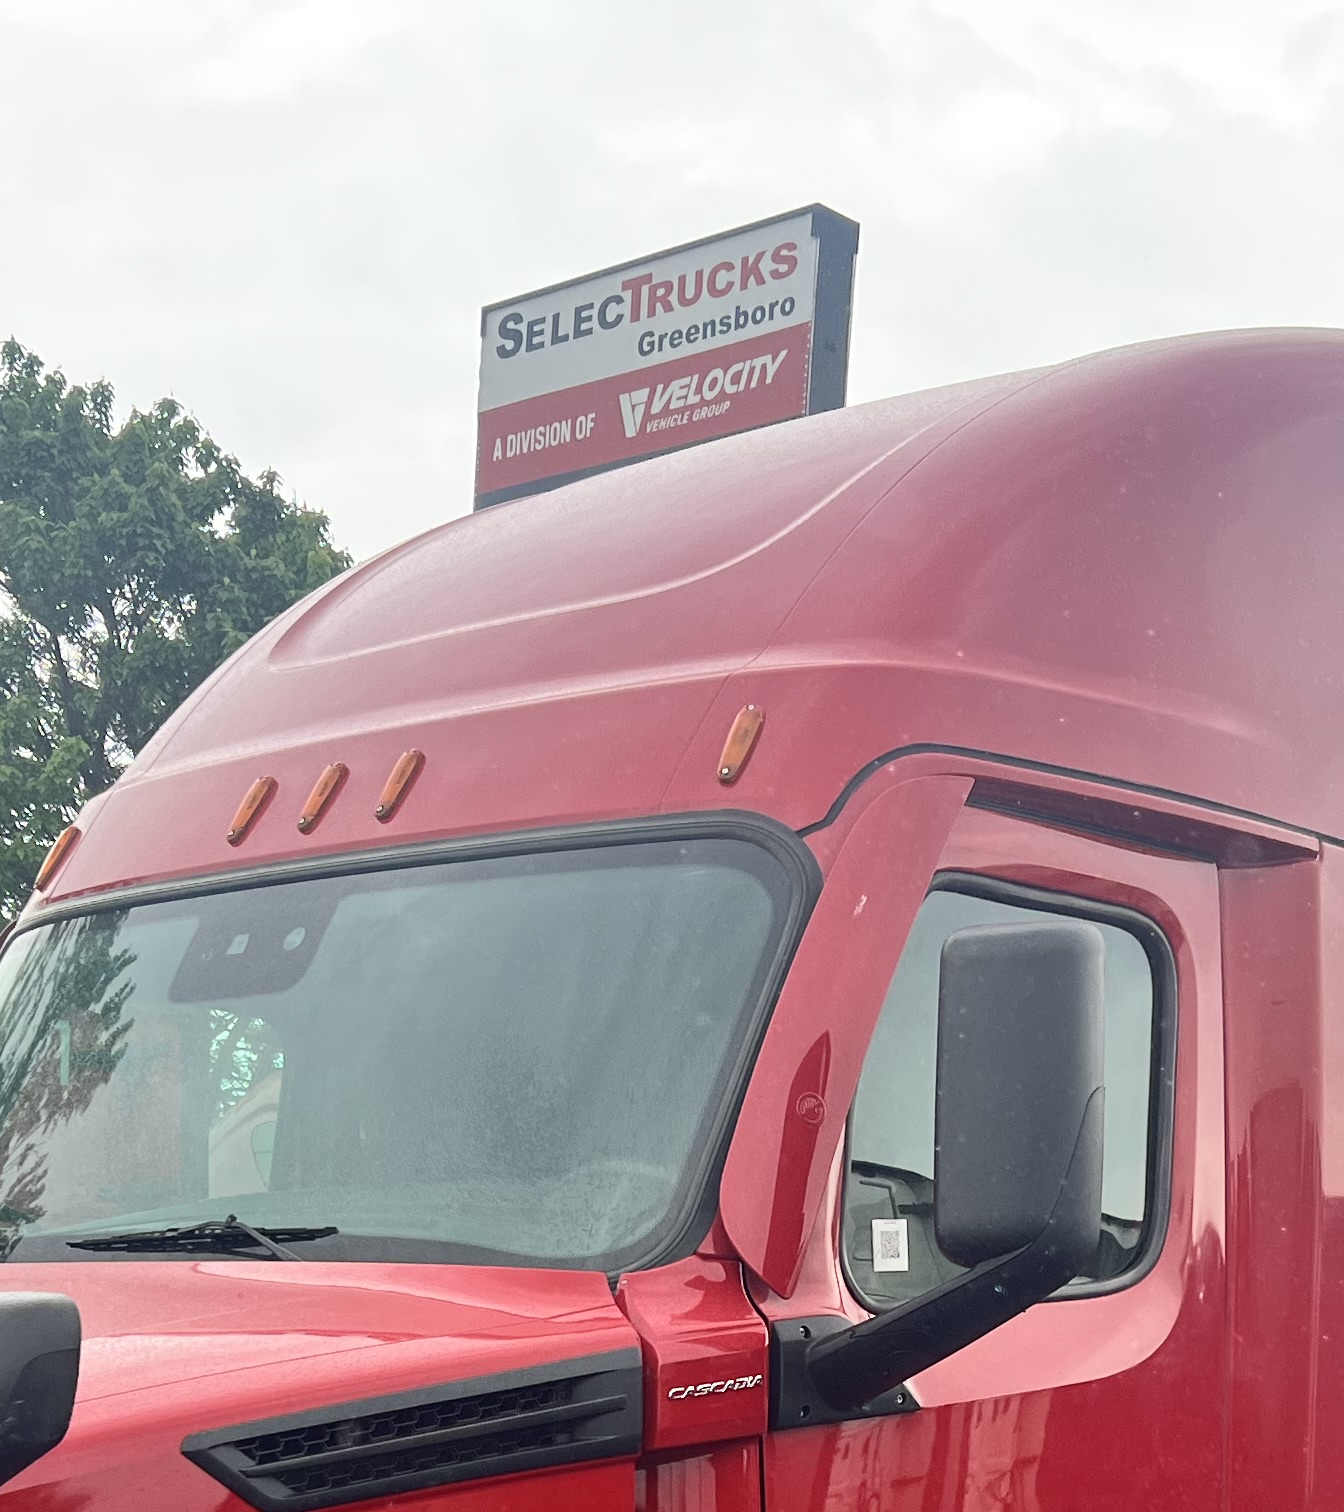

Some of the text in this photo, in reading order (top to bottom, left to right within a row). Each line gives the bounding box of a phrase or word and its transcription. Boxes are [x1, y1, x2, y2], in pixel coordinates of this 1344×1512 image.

[638, 296, 796, 357] Greensboro
[650, 350, 788, 414] VELOCITY
[492, 413, 596, 461] A DIVISION OF
[646, 401, 731, 434] VEHICLE GROUP
